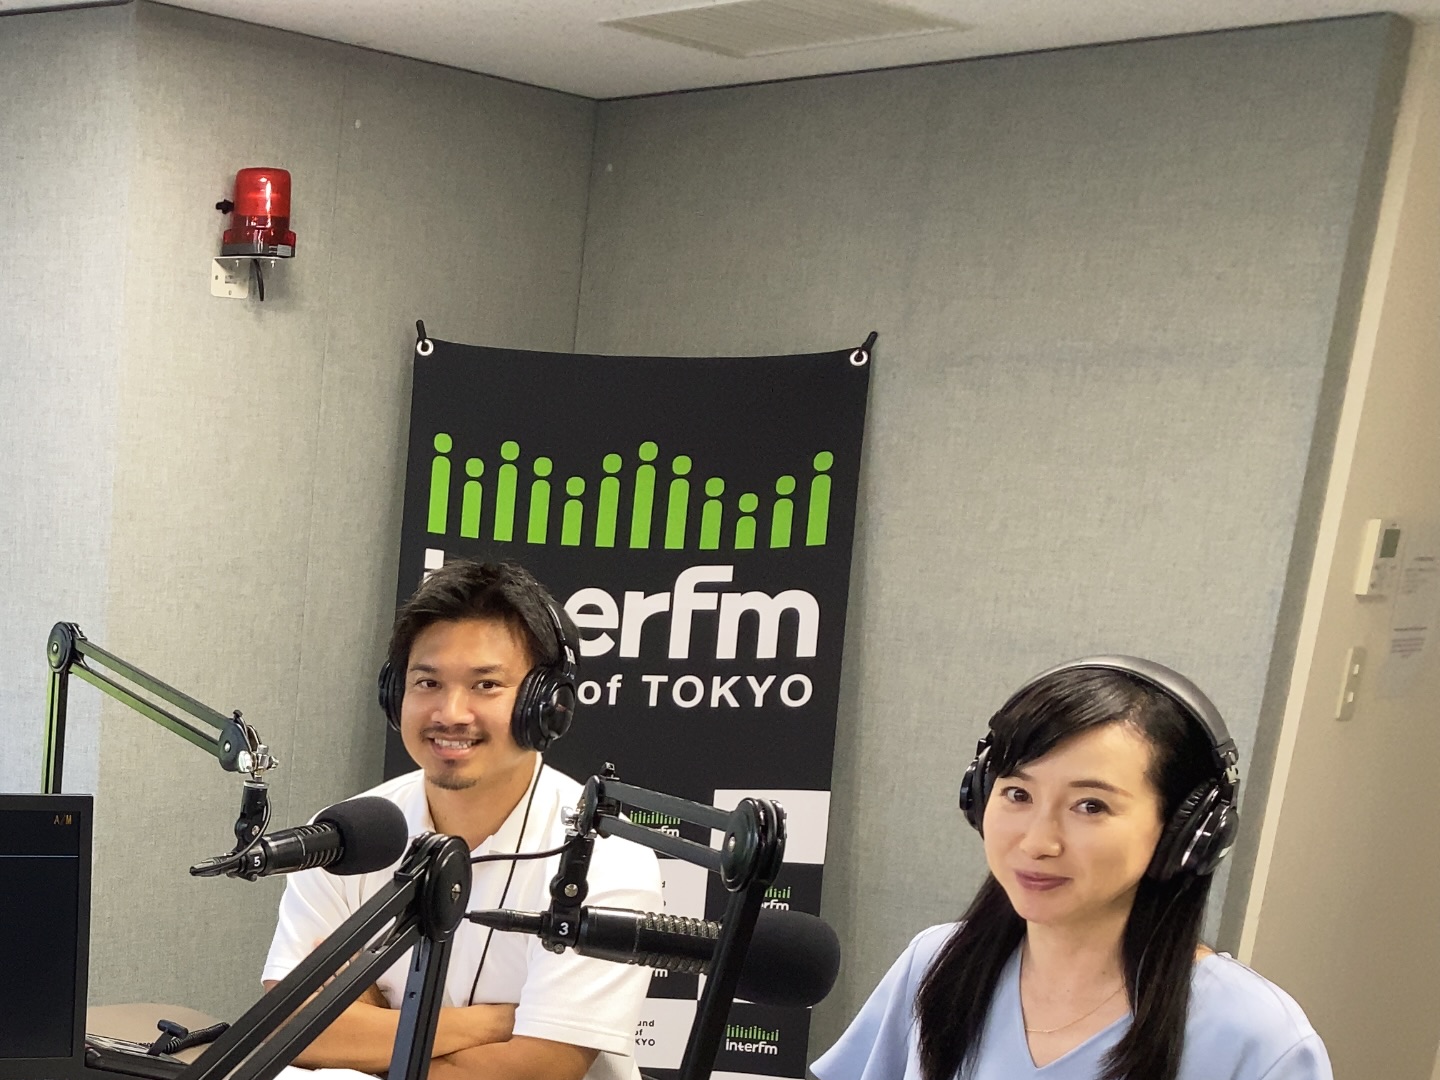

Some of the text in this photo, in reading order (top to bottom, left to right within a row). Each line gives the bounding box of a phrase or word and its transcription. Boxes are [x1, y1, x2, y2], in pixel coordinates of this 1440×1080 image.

[422, 548, 819, 660] erfm
[578, 674, 813, 707] of TOKYO
[254, 856, 260, 866] 5
[559, 922, 568, 935] 3
[725, 1039, 778, 1055] interfm
